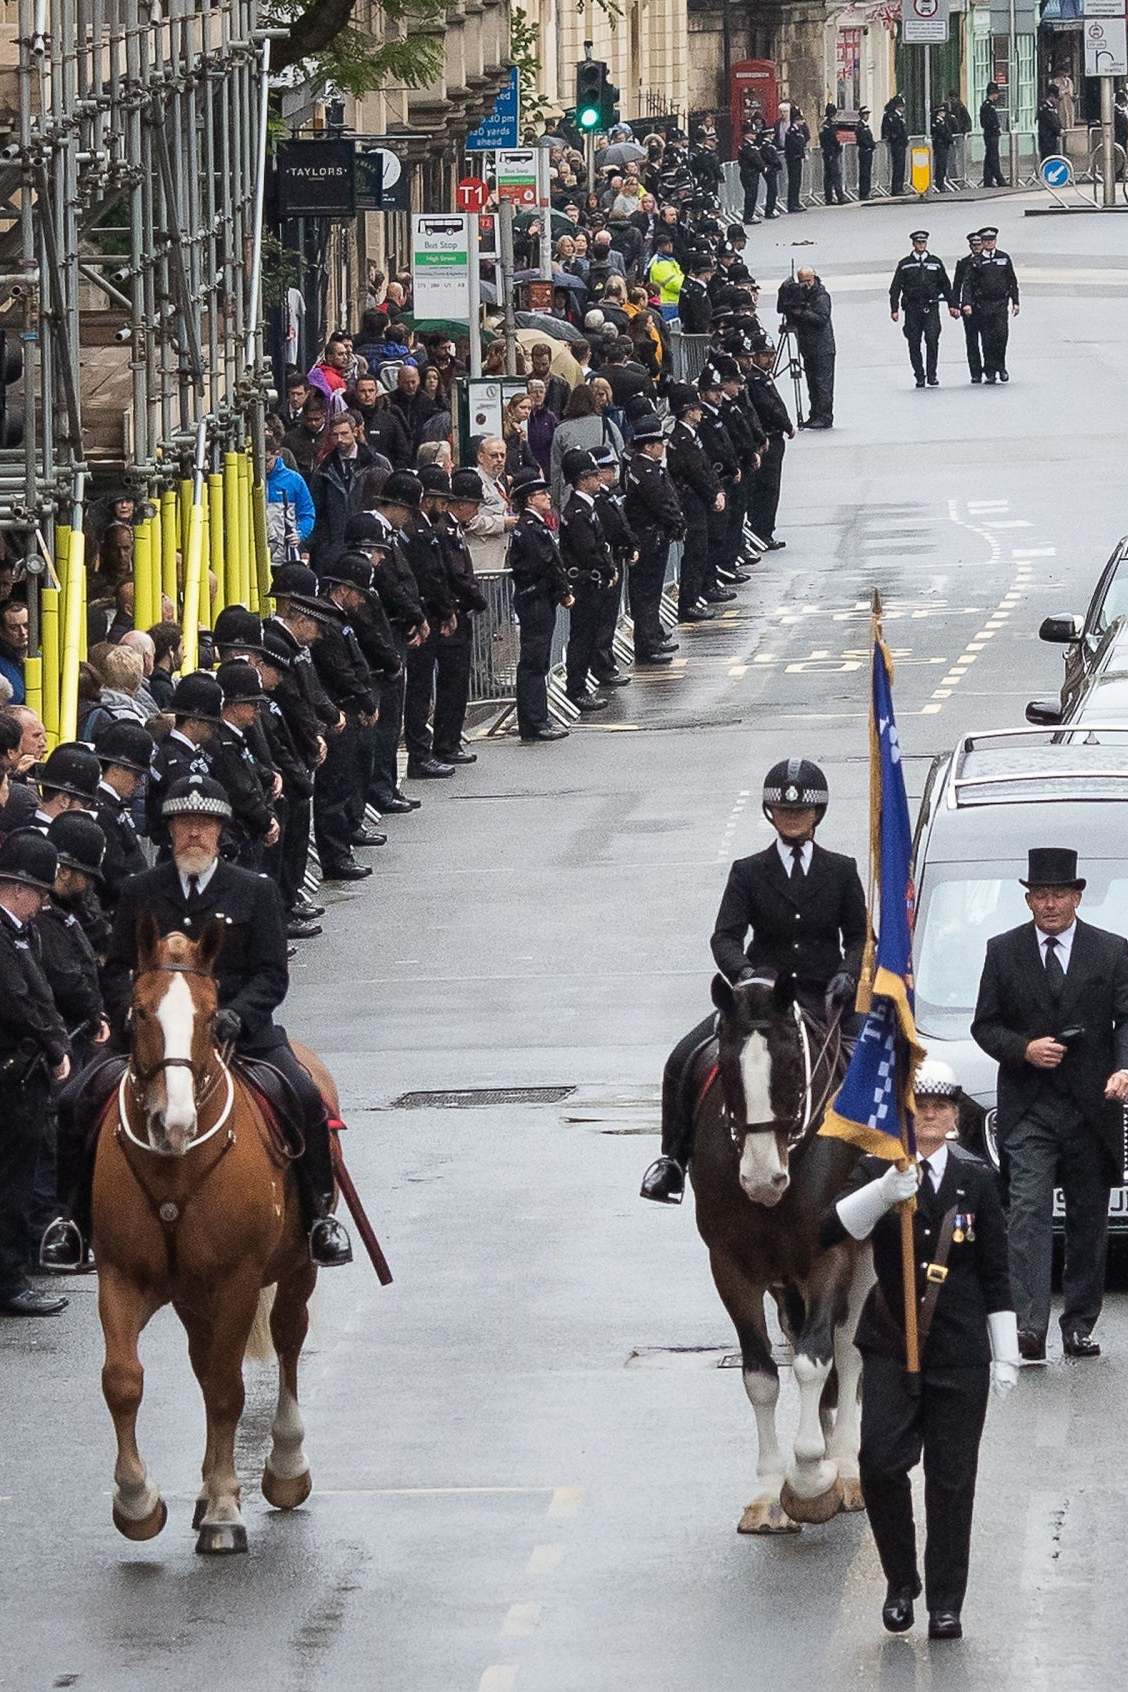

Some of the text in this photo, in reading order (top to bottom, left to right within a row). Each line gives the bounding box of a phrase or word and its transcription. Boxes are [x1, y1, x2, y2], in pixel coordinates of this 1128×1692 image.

[487, 127, 510, 137] yards
[290, 167, 343, 176] TAYLORS
[460, 187, 483, 204] T1
[424, 241, 458, 250] Bus Stop
